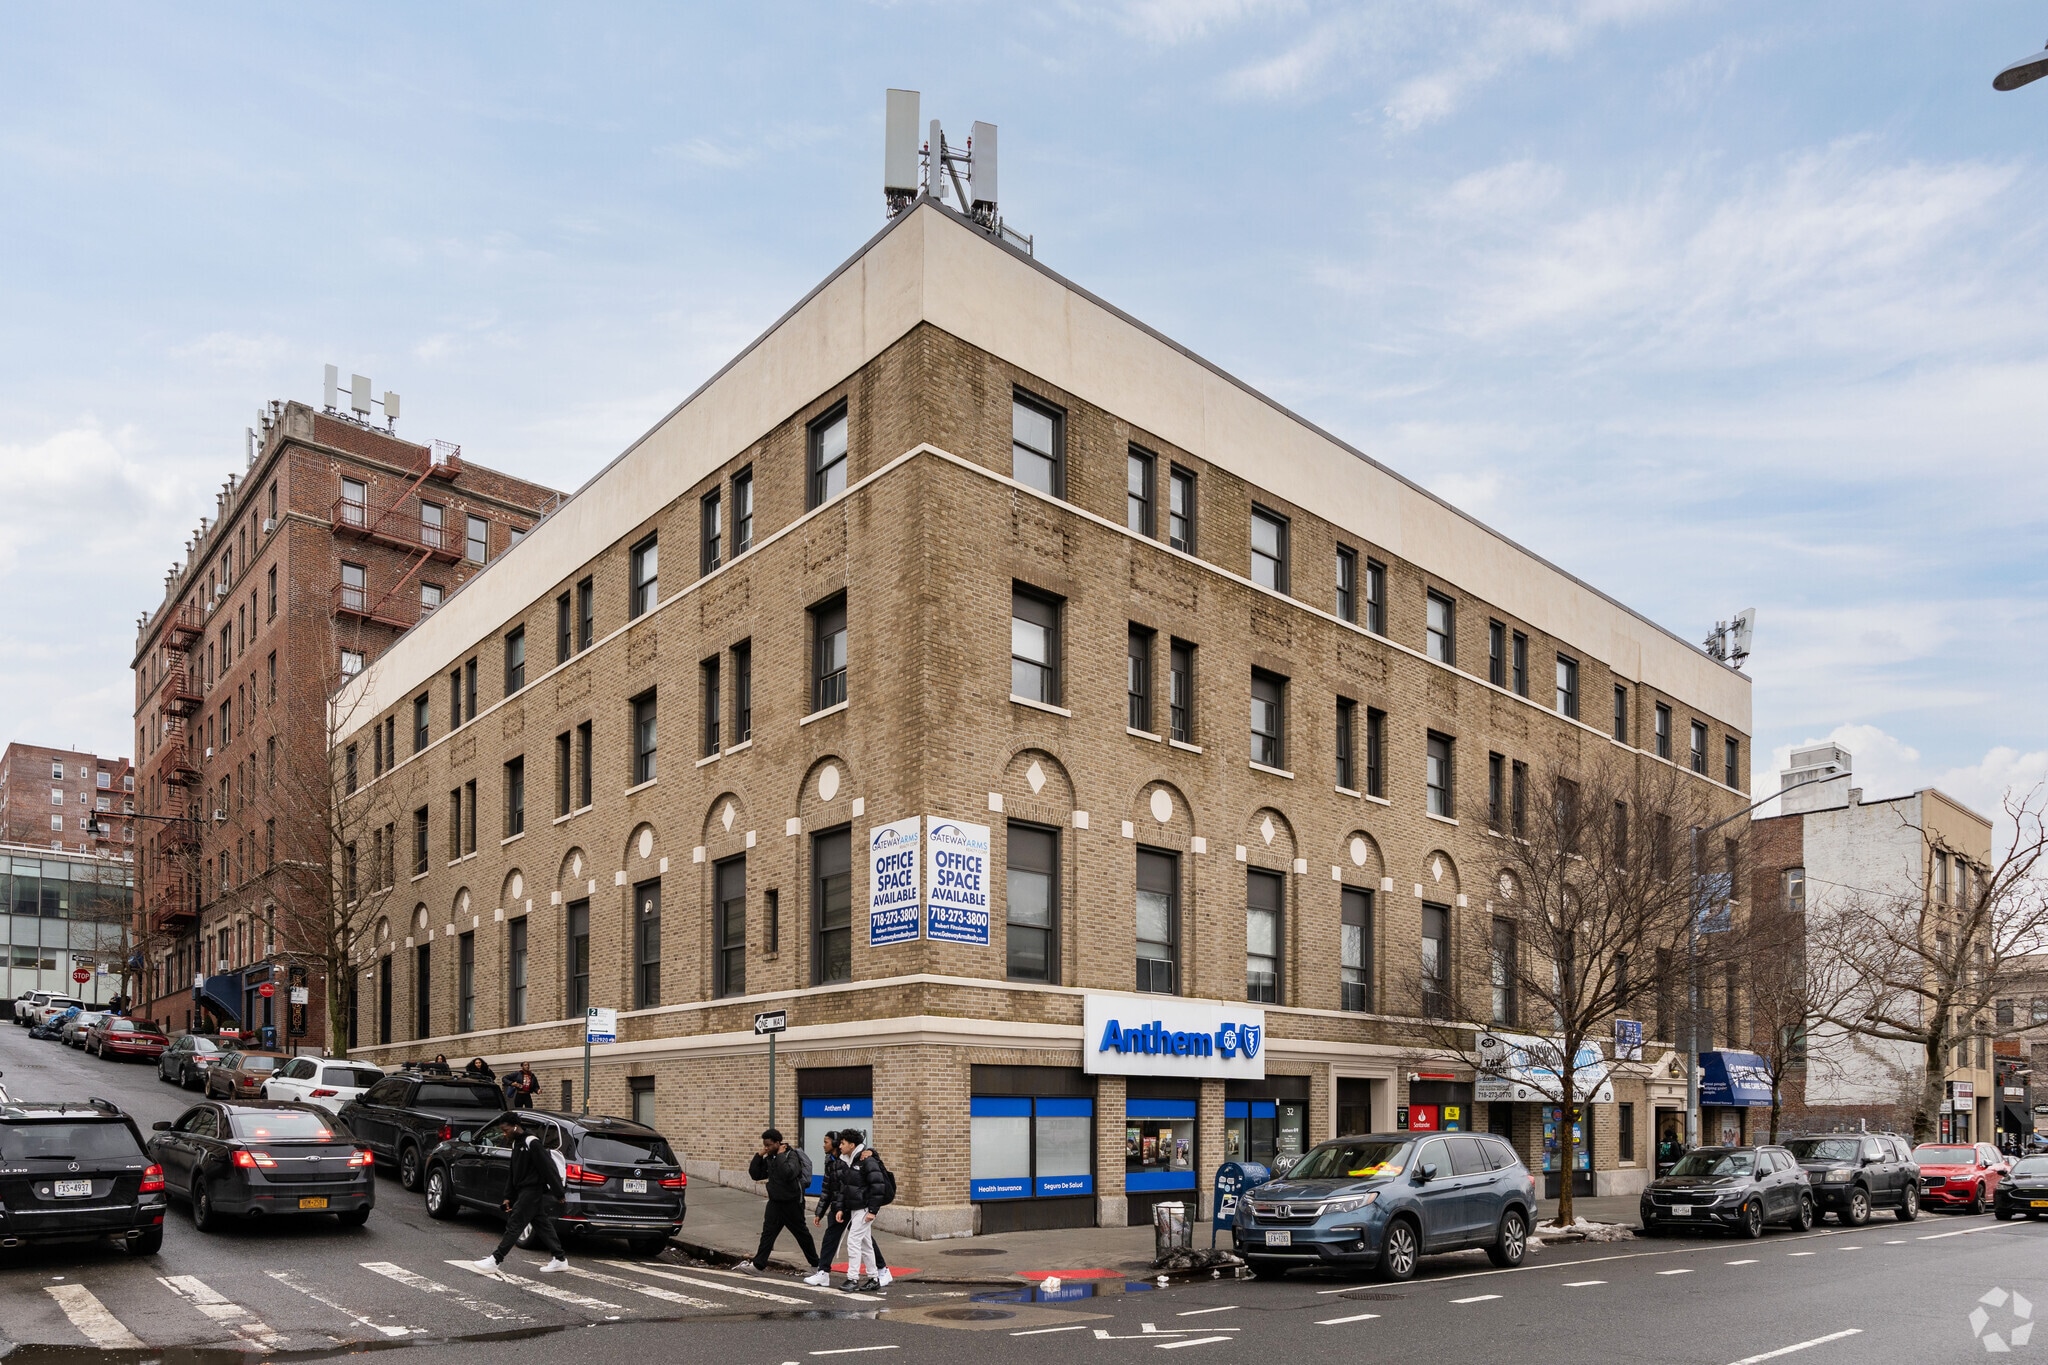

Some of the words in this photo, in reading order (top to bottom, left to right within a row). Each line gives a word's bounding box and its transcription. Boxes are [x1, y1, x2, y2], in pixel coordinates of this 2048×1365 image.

[876, 850, 914, 874] OFFICE
[935, 850, 982, 874] OFFICE
[878, 869, 912, 892] SPACE
[938, 869, 980, 891] SPACE
[873, 887, 916, 907] AVAILABLE
[931, 887, 986, 906] AVAILABLE
[872, 907, 918, 928] 718-273-3800
[930, 907, 988, 926] 718-273-3800
[759, 1019, 768, 1028] ONE
[773, 1017, 783, 1026] WAY
[1098, 1020, 1213, 1056] Anthem
[1287, 1107, 1294, 1116] 32
